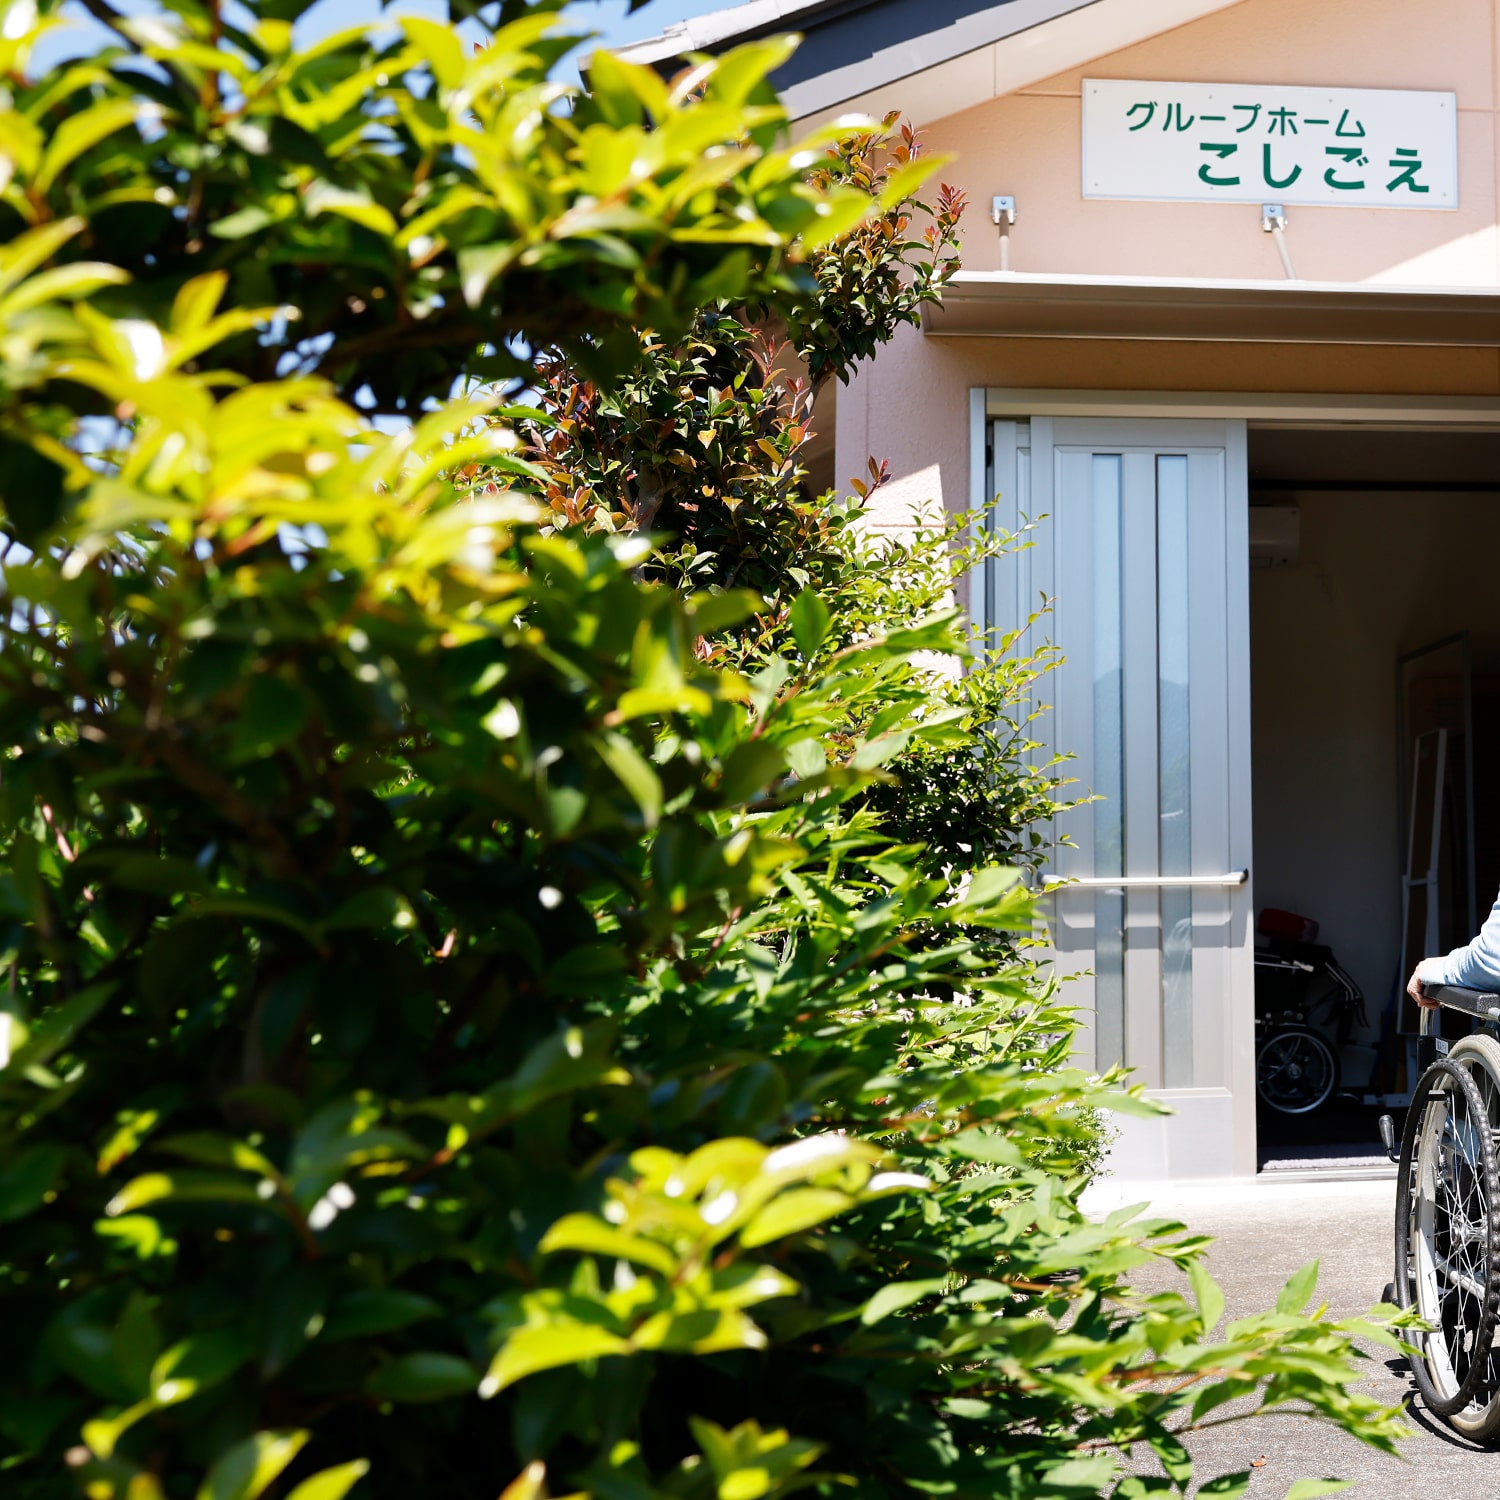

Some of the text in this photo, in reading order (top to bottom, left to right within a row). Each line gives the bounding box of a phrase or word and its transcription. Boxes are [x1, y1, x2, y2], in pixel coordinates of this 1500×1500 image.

[1126, 101, 1366, 138] グループホーム
[1198, 142, 1430, 193] こしごえ
